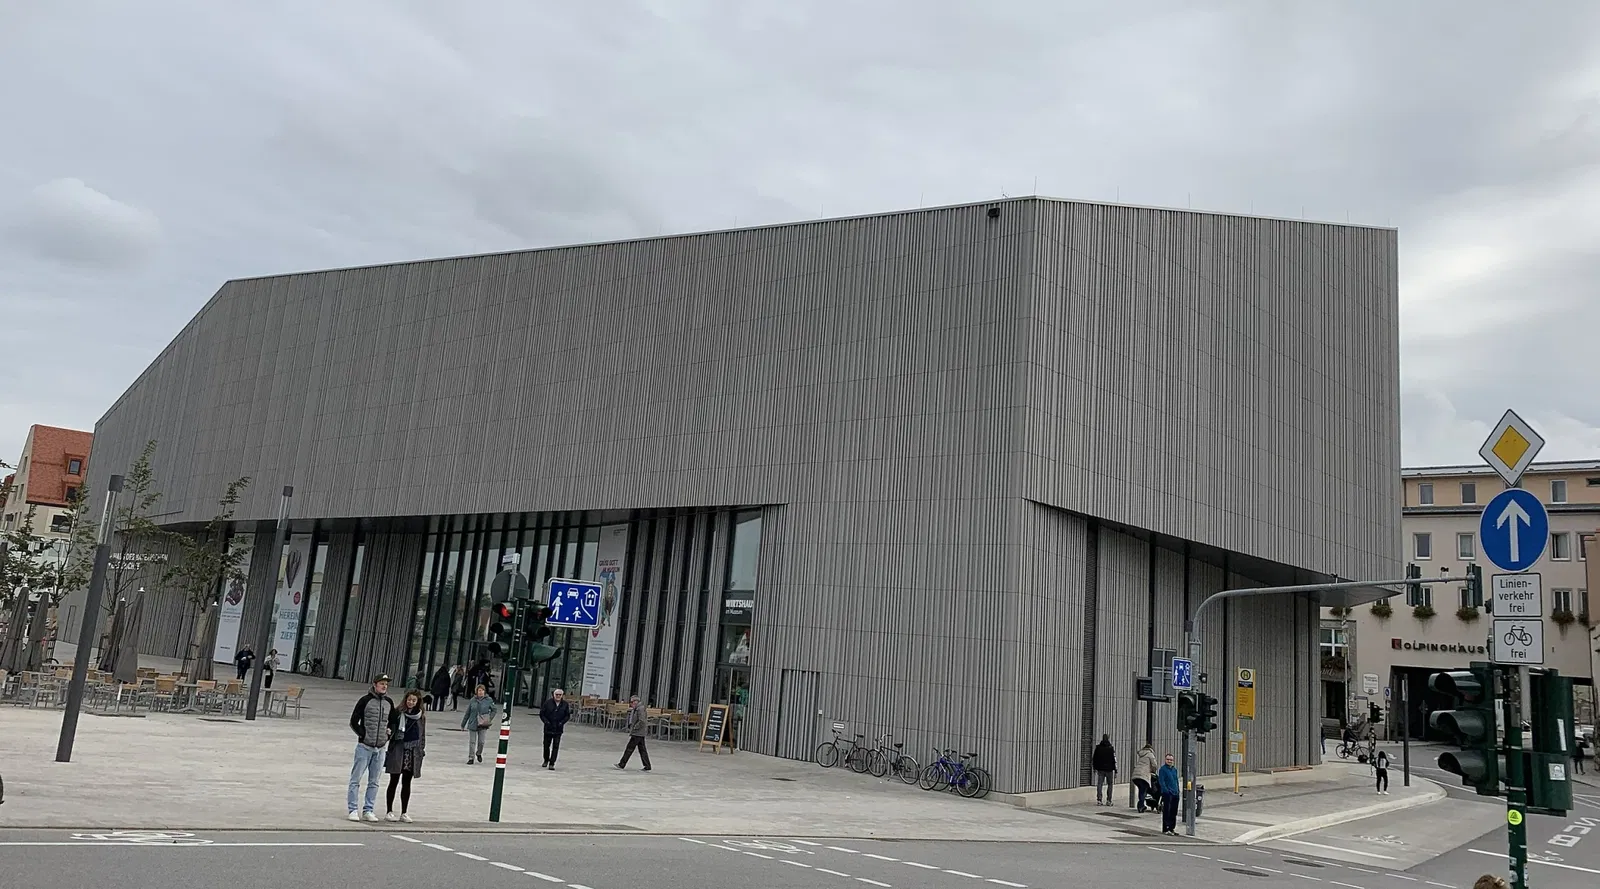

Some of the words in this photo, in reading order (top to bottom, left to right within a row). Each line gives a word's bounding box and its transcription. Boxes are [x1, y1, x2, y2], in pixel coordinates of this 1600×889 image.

[1500, 579, 1532, 589] Linien-
[1498, 591, 1534, 600] verkehr
[1509, 603, 1525, 612] frei
[1510, 649, 1527, 658] frei
